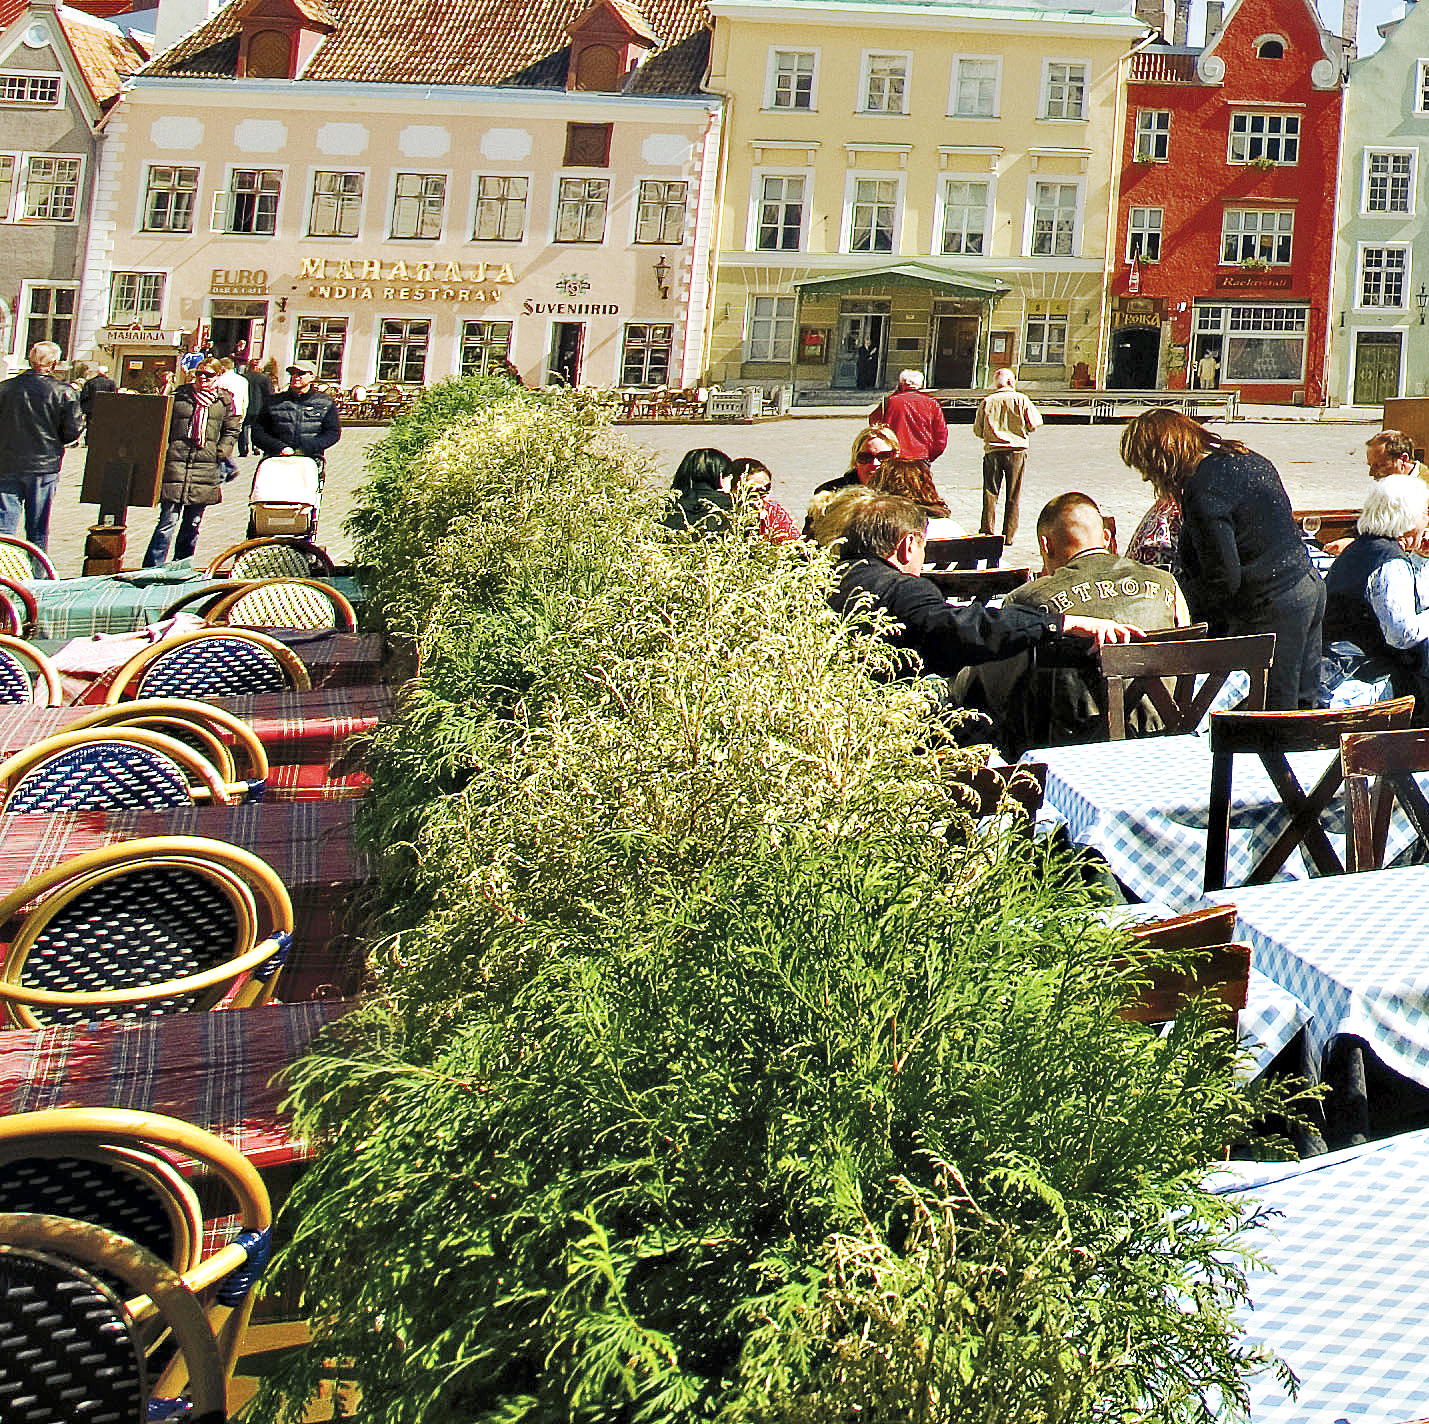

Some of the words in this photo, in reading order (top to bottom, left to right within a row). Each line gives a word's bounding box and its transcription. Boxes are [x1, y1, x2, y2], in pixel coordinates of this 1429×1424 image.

[211, 269, 268, 286] EURO
[300, 257, 517, 284] MAHARAJA
[309, 286, 373, 300] INDIA
[383, 287, 502, 303] RESTORAN
[520, 298, 619, 316] SUVENIIRID
[1112, 312, 1160, 328] TROIKA
[1040, 577, 1175, 614] ETROFF
